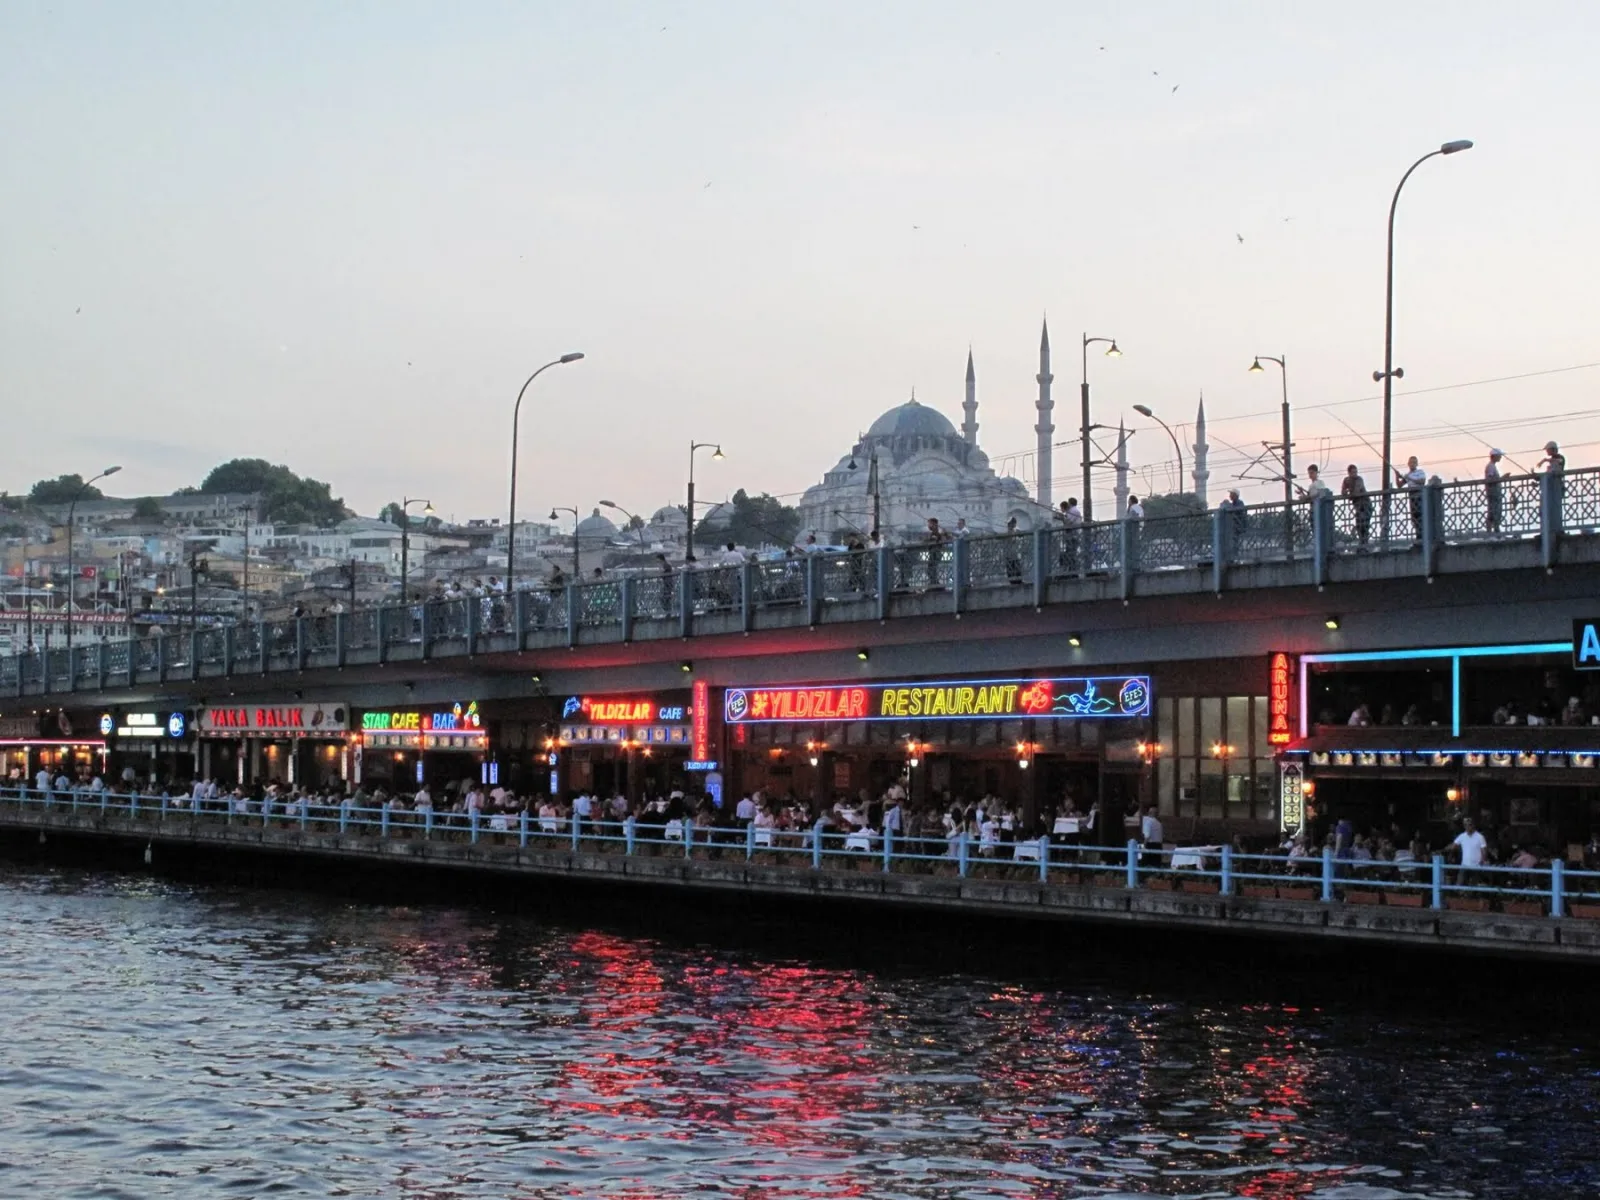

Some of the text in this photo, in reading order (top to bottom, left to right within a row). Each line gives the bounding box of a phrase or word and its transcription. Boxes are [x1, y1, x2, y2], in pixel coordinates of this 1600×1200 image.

[1124, 686, 1143, 702] EFES
[1274, 654, 1287, 729] ARUNA
[770, 684, 1018, 718] YILDIZLAR RESTAURANT
[210, 708, 248, 727] YAKA
[255, 708, 304, 727] BALIK
[362, 712, 390, 729] STAR
[392, 712, 420, 729] CAFE
[432, 713, 455, 729] BAR
[590, 703, 651, 720] YILDIZLAR
[659, 707, 682, 720] CAFE
[696, 682, 706, 759] YILDIZLAR
[1272, 734, 1290, 743] CAFE
